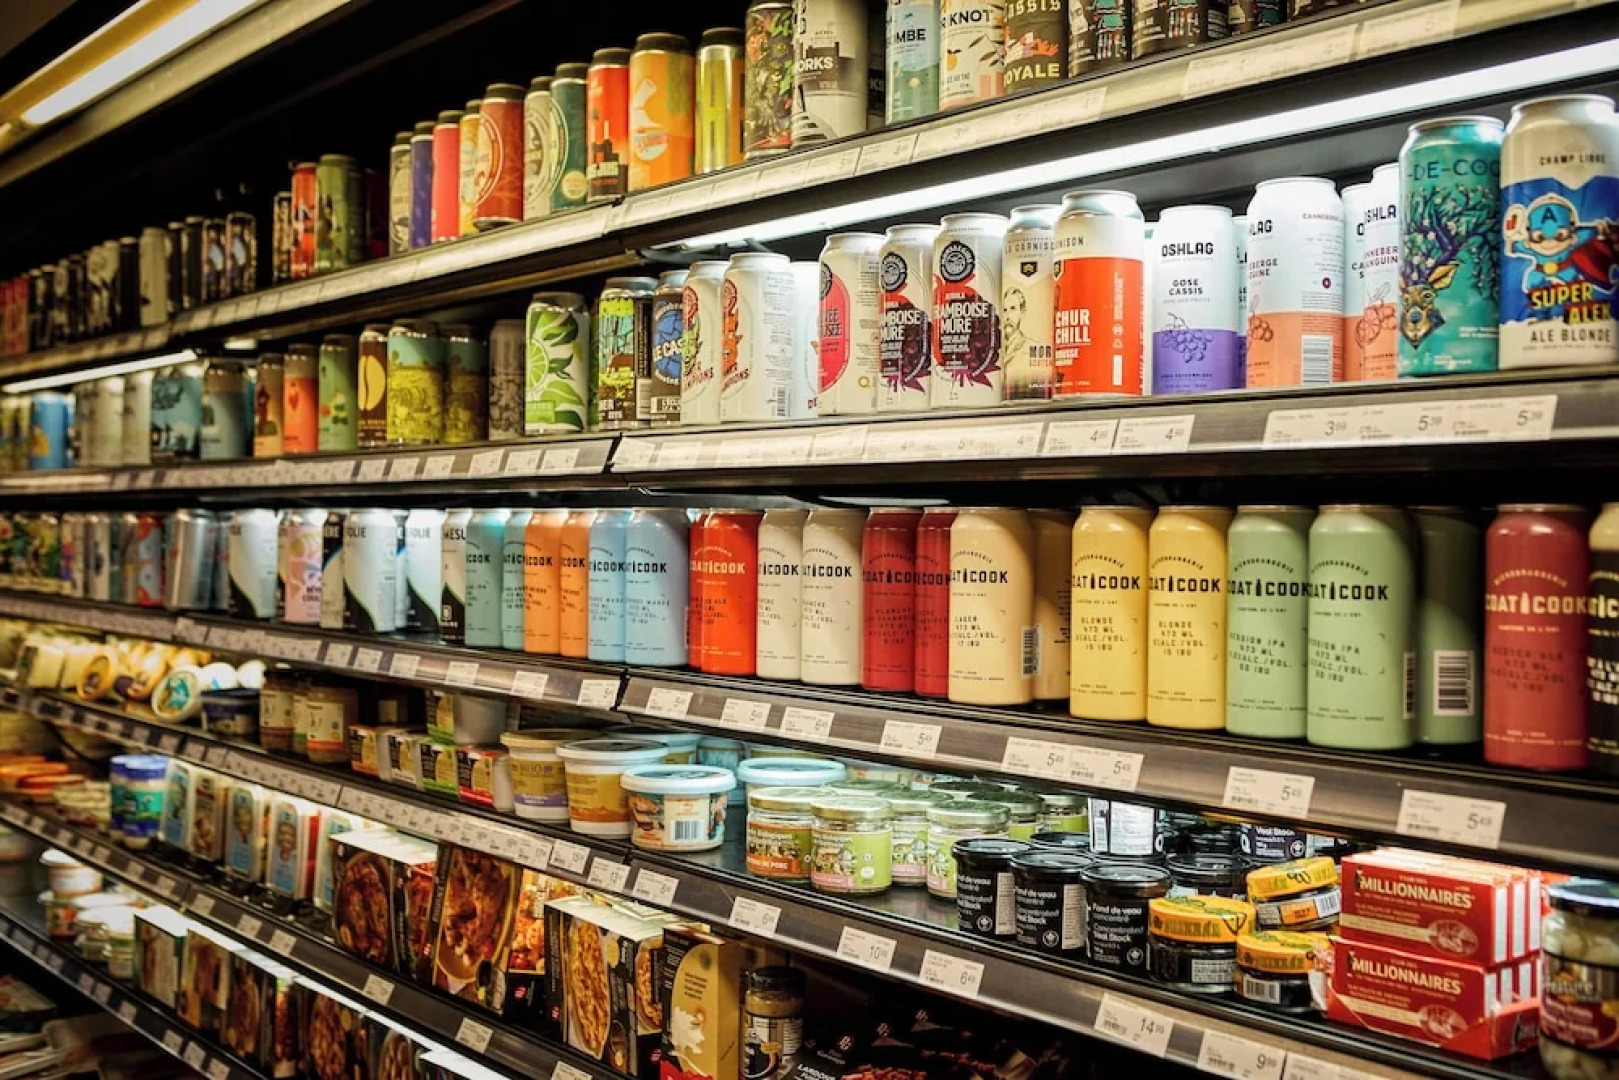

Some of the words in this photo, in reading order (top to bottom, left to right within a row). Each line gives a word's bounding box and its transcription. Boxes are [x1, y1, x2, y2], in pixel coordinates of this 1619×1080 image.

[949, 9, 990, 26] KNOT
[1162, 242, 1214, 261] OSHLAG
[1168, 287, 1204, 297] CASSIS
[1531, 281, 1594, 311] SUPER
[1055, 308, 1091, 329] CHUR
[1055, 326, 1091, 345] CHILL
[1531, 328, 1556, 343] ALE
[1080, 615, 1114, 625] BLONDE
[1158, 619, 1193, 630] BLONDE
[1359, 875, 1473, 909] MILLIONNAIRES
[1122, 906, 1142, 917] veau
[1351, 958, 1463, 998] MILLIONNAIRES
